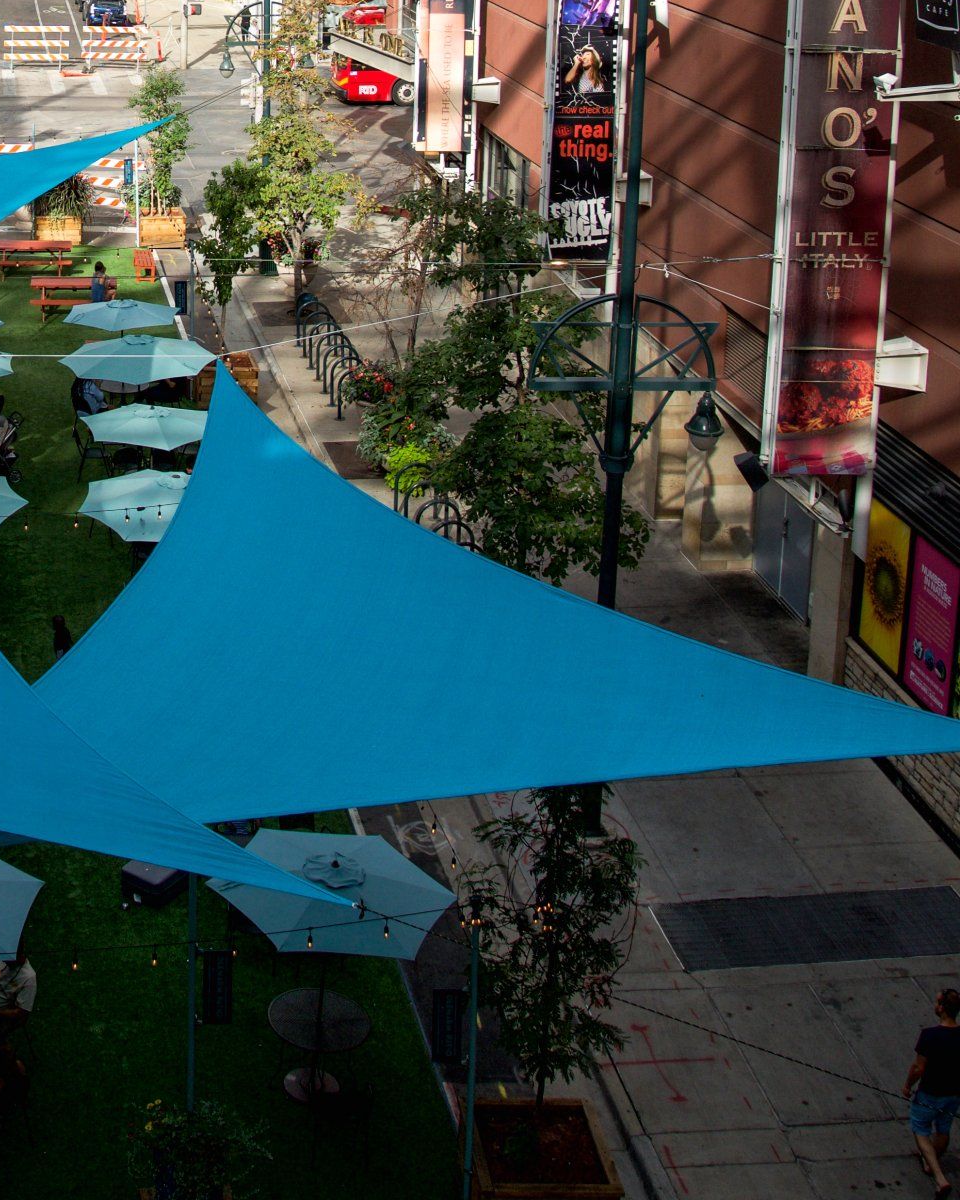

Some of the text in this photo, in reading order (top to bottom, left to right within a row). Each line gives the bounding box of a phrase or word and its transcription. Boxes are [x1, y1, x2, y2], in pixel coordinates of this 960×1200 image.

[926, 4, 949, 17] CAFE
[358, 85, 378, 95] RTD
[441, 97, 450, 115] THE
[578, 106, 601, 115] check
[573, 120, 610, 139] real
[559, 139, 614, 162] thing.
[549, 197, 609, 219] COYOTE
[564, 211, 611, 238] UGLY
[795, 231, 879, 246] LITTLE
[921, 563, 948, 592] NUMBERS
[931, 579, 952, 606] NATURE
